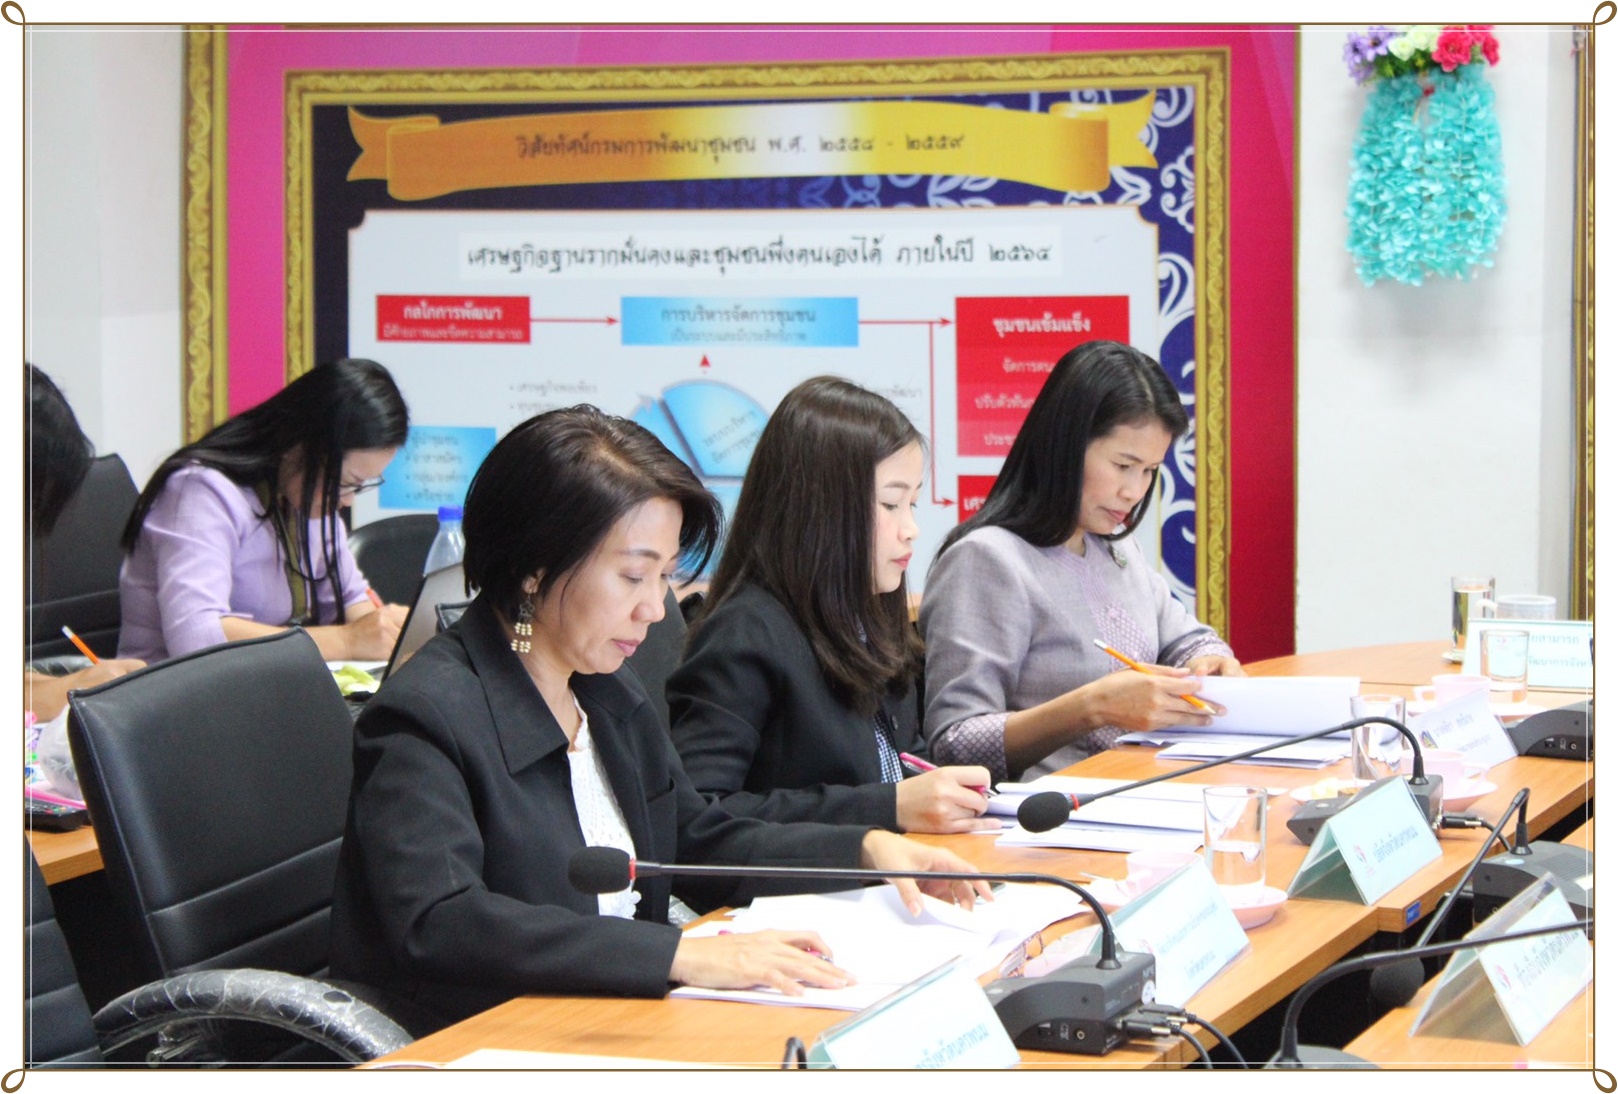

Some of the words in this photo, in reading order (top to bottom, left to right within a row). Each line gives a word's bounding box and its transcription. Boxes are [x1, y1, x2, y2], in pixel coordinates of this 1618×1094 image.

[896, 233, 974, 267] ภายในปี
[988, 243, 1053, 263] ๒๕๖๔
[992, 311, 1092, 338] ชุมชนเข้มแข็ง
